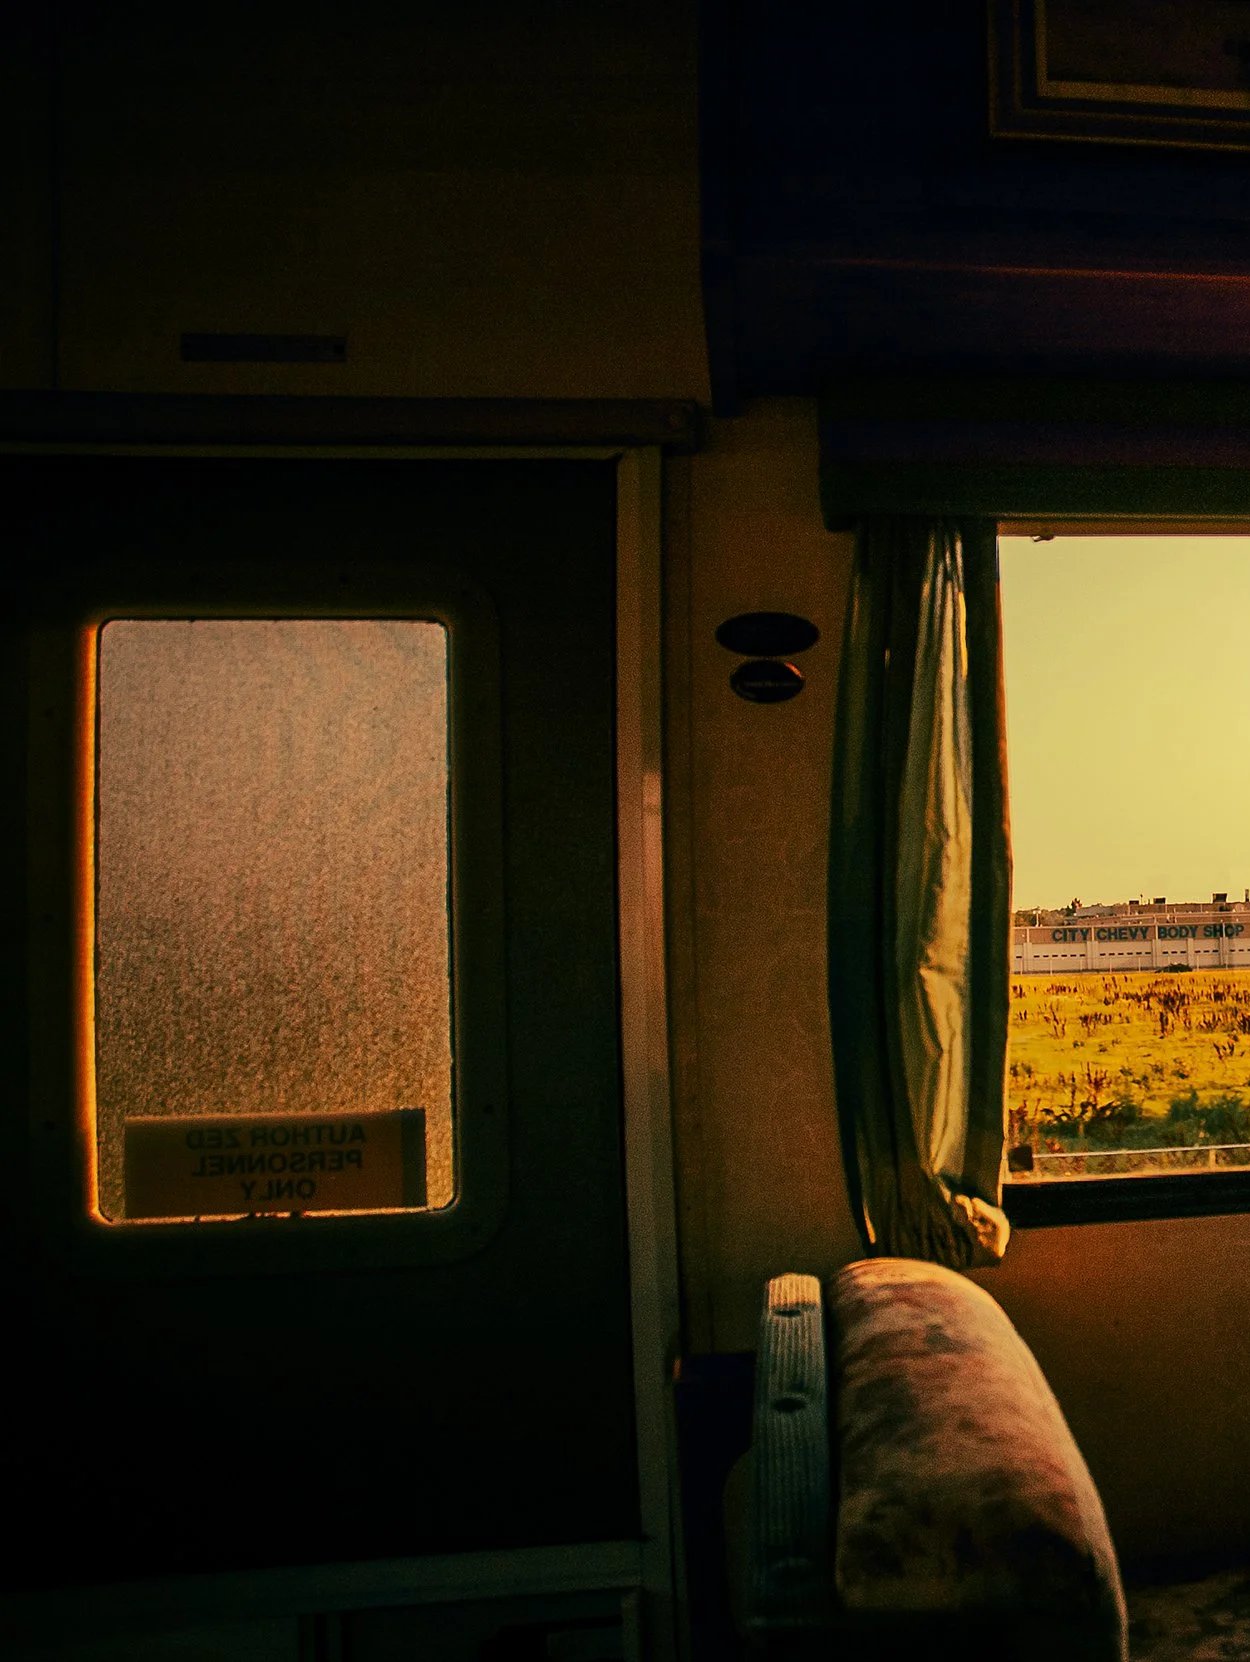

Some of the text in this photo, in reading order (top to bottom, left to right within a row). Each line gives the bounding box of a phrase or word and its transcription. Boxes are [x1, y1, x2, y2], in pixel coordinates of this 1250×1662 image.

[1052, 925, 1244, 942] CITY CHEVY BODY SHOP
